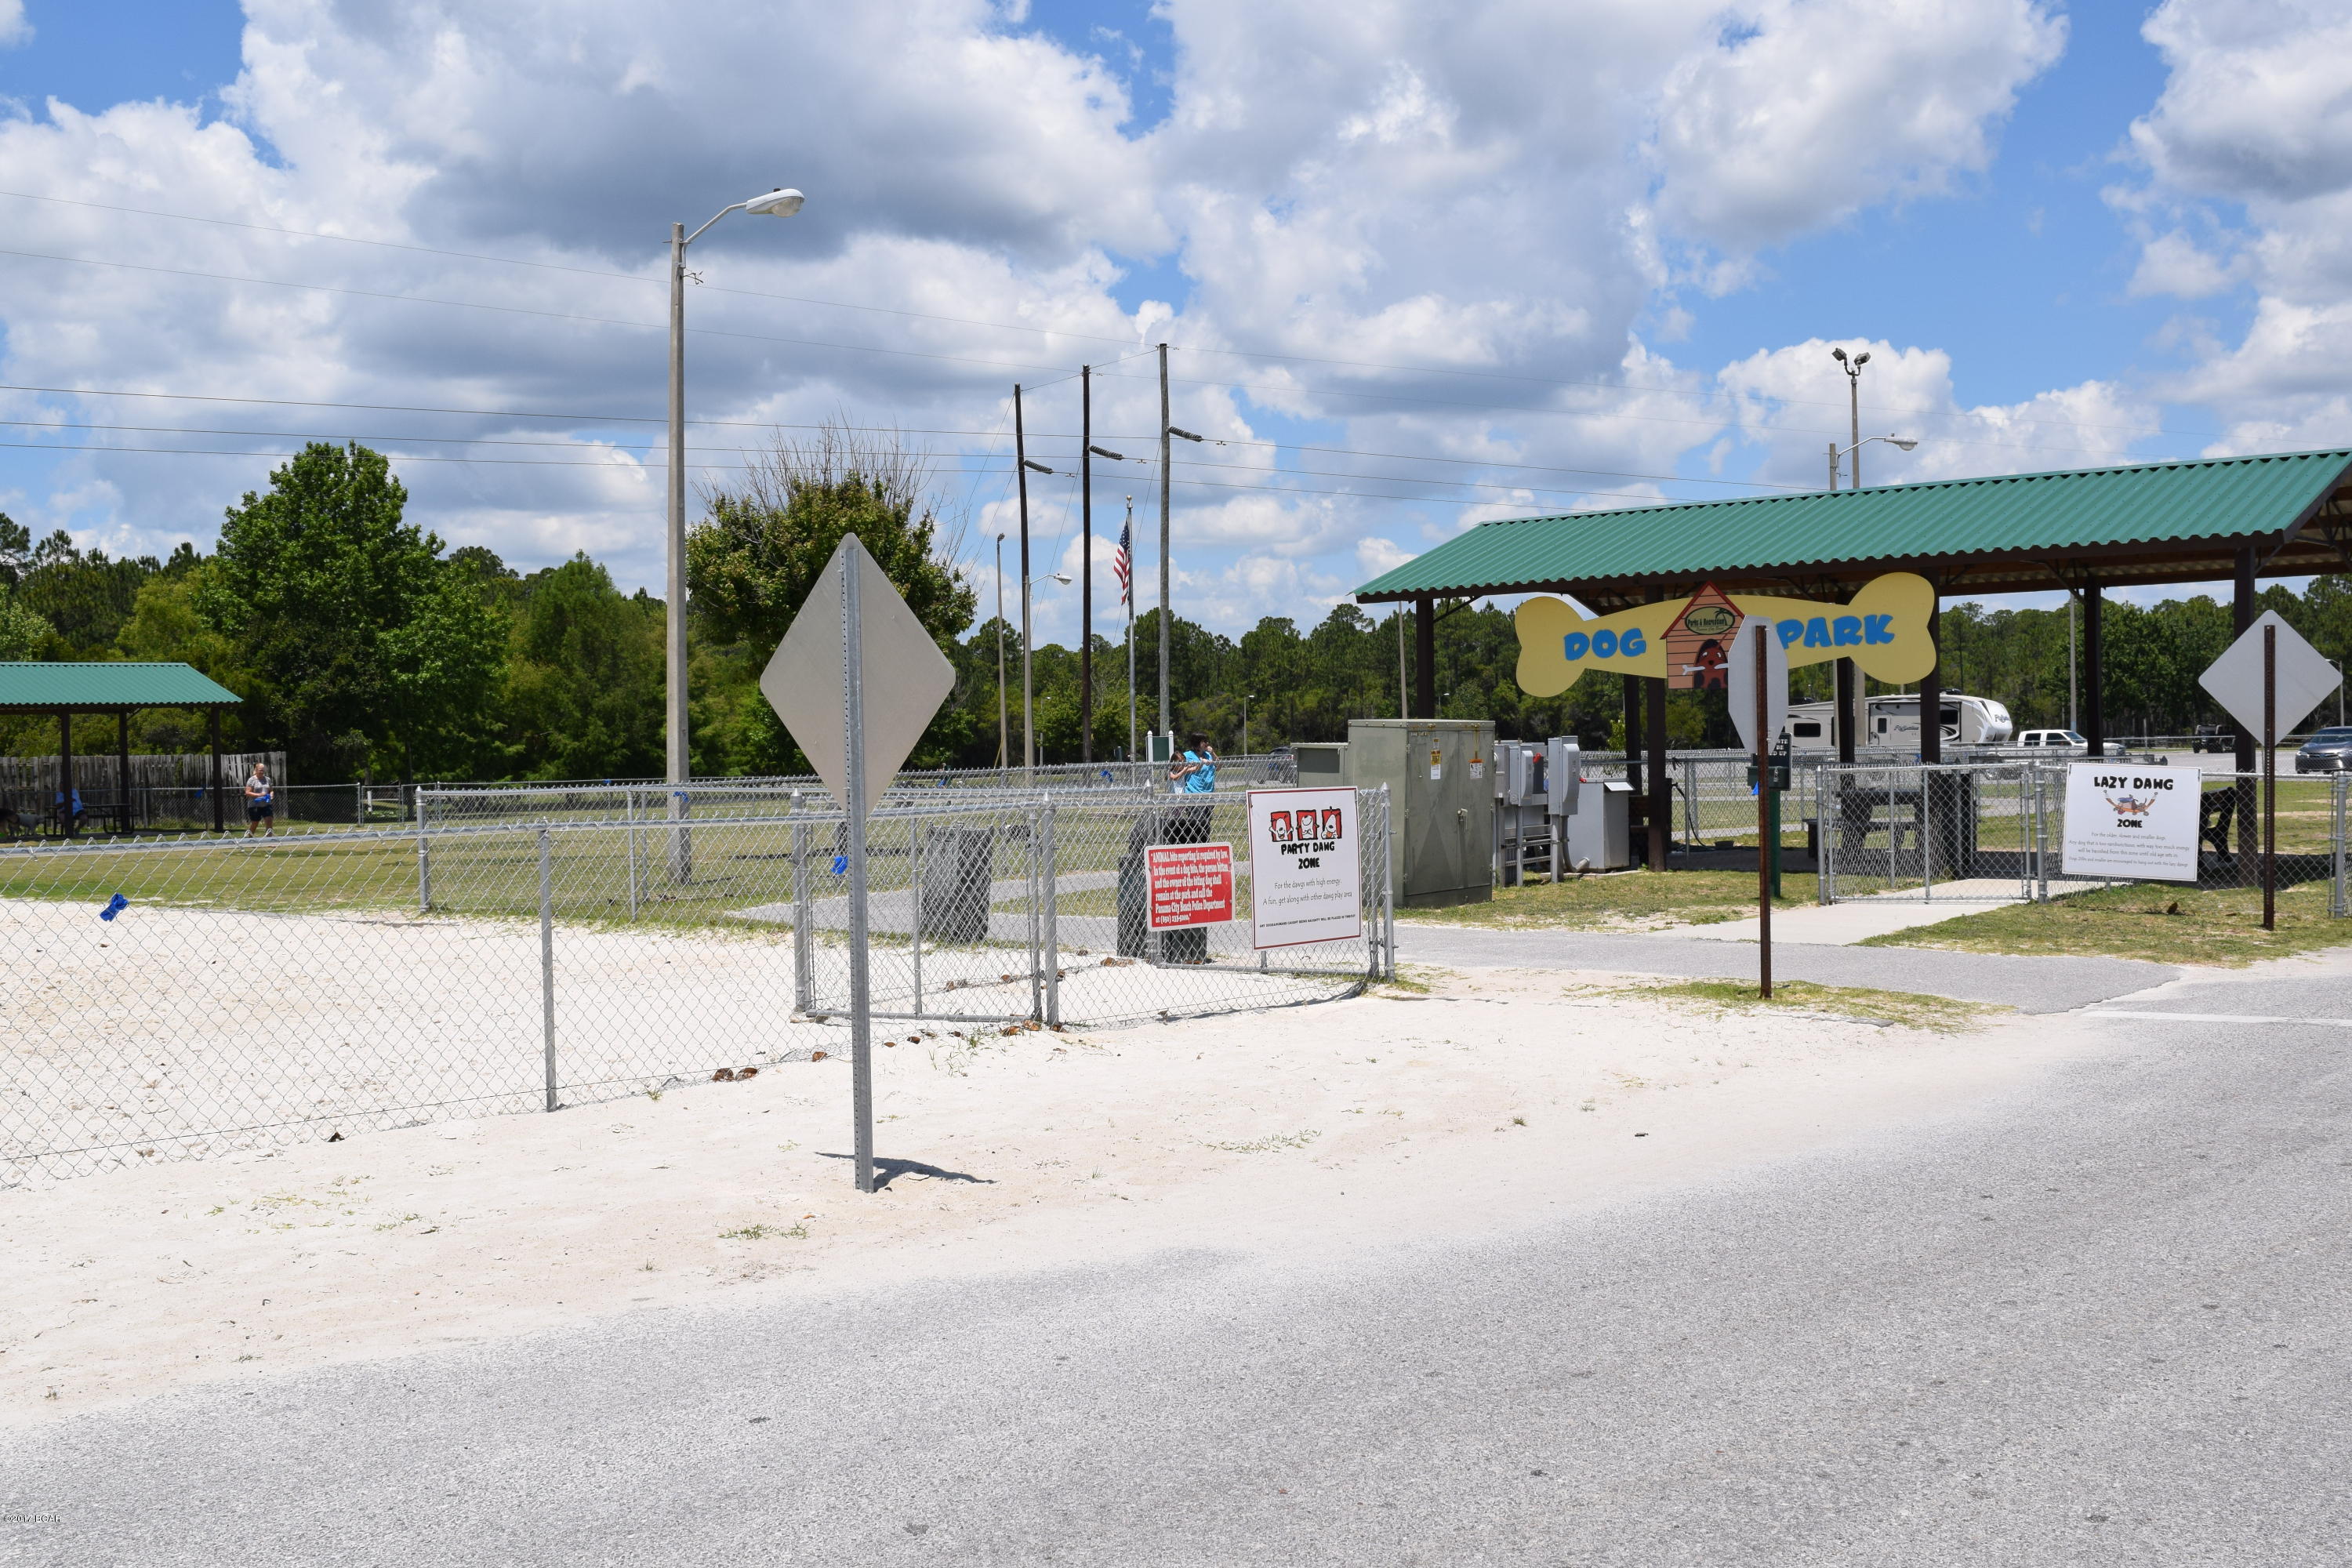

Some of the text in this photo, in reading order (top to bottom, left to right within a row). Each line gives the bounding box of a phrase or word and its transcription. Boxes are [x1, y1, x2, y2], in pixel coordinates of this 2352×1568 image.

[1687, 619, 1699, 627] Parks
[1564, 614, 1895, 661] DOG PARK
[2094, 775, 2174, 790] LAZY DAWG
[2117, 818, 2143, 828] ZONE
[1280, 841, 1335, 855] PARTY DAWG
[1178, 851, 1196, 863] reporting
[1196, 850, 1200, 860] is
[1200, 849, 1215, 862] required
[1216, 849, 1220, 862] by
[1166, 866, 1175, 875] event
[1176, 864, 1180, 874] of
[1205, 864, 1217, 876] person
[1298, 858, 1319, 869] ZONE
[1170, 878, 1182, 887] owner
[1182, 876, 1186, 886] of
[1213, 874, 1221, 884] shall
[1292, 880, 1305, 890] dawgs
[1306, 878, 1315, 887] with
[1316, 877, 1326, 887] high
[1156, 891, 1169, 901] remain
[1170, 891, 1174, 900] at
[1181, 888, 1191, 901] park
[1287, 895, 1299, 904] along
[1300, 893, 1309, 902] with
[1323, 891, 1334, 901] dawg
[1334, 891, 1343, 900] play
[1156, 898, 1225, 915] Panama City Beach Police Department
